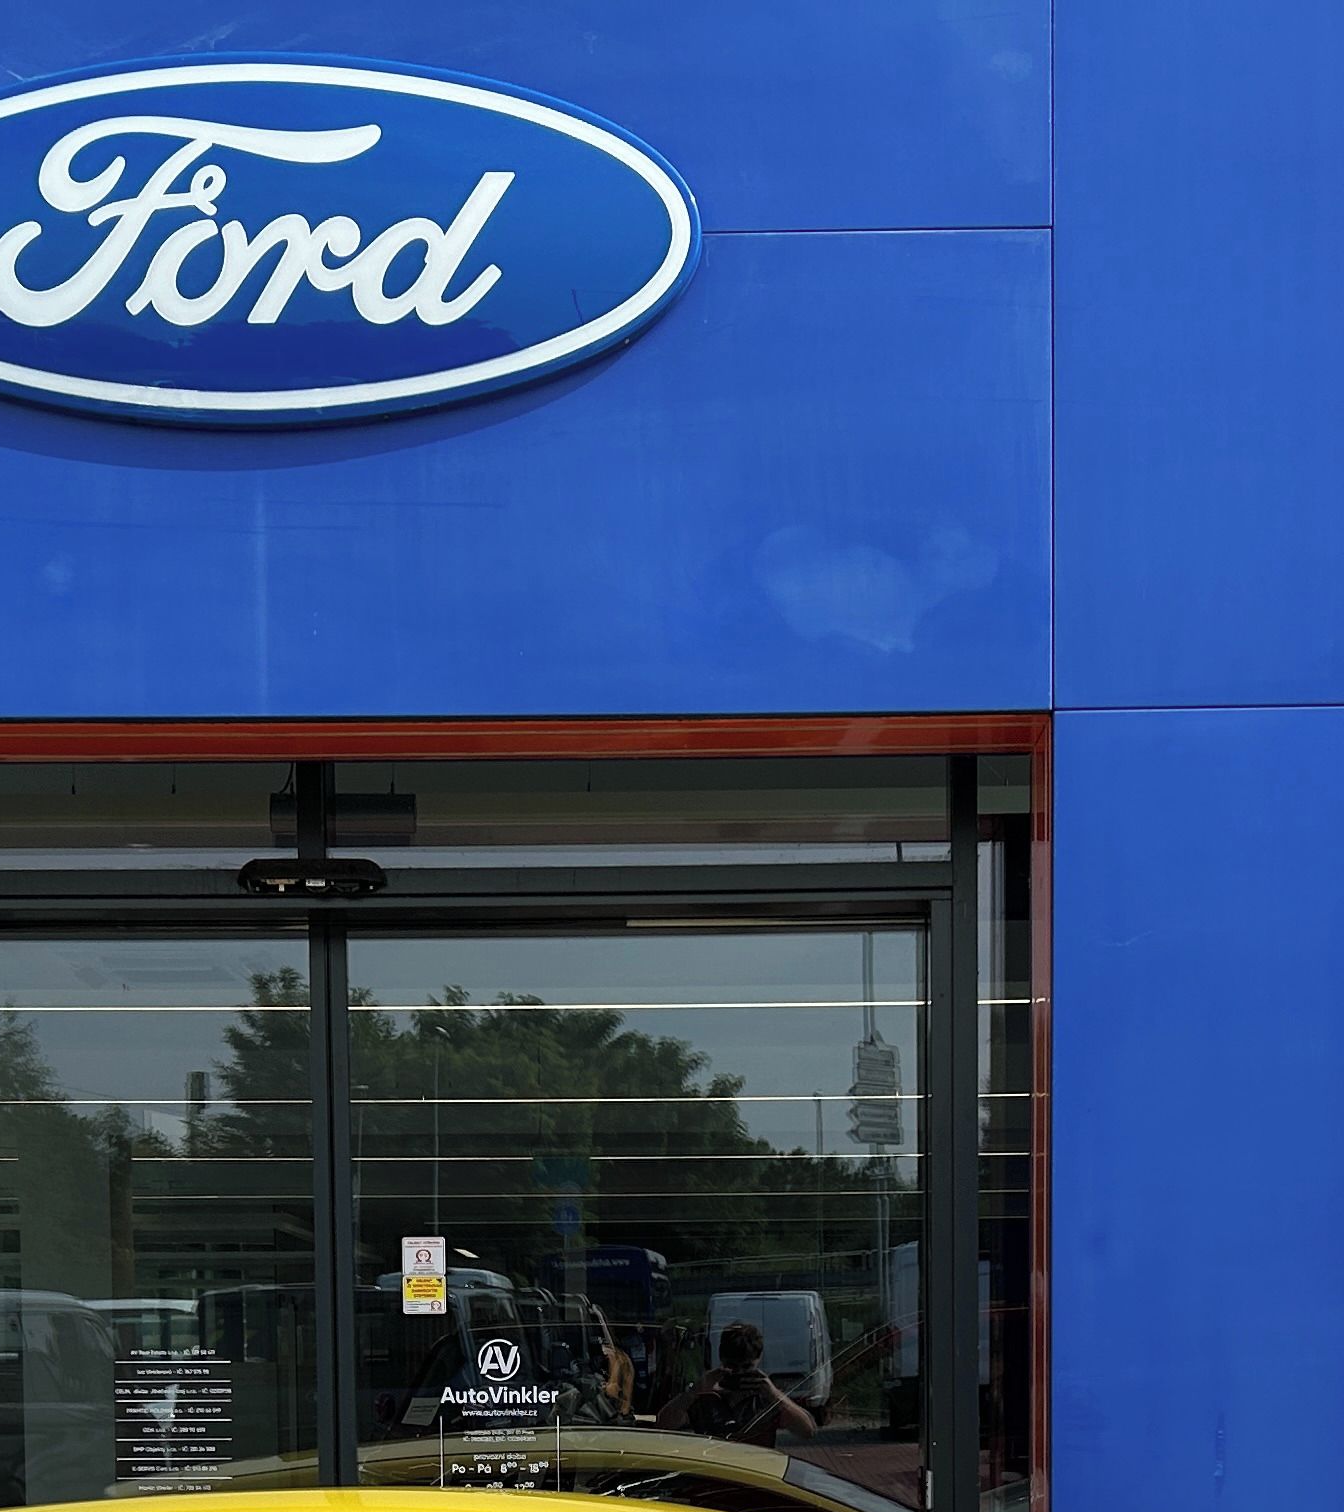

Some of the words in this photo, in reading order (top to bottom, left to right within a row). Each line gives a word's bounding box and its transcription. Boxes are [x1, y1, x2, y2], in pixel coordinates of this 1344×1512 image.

[479, 1346, 519, 1375] AV
[441, 1385, 559, 1404] AutoVinkler
[461, 1408, 538, 1417] www.autovinkler.cz
[451, 1463, 466, 1474] Po
[477, 1463, 492, 1474] Pá
